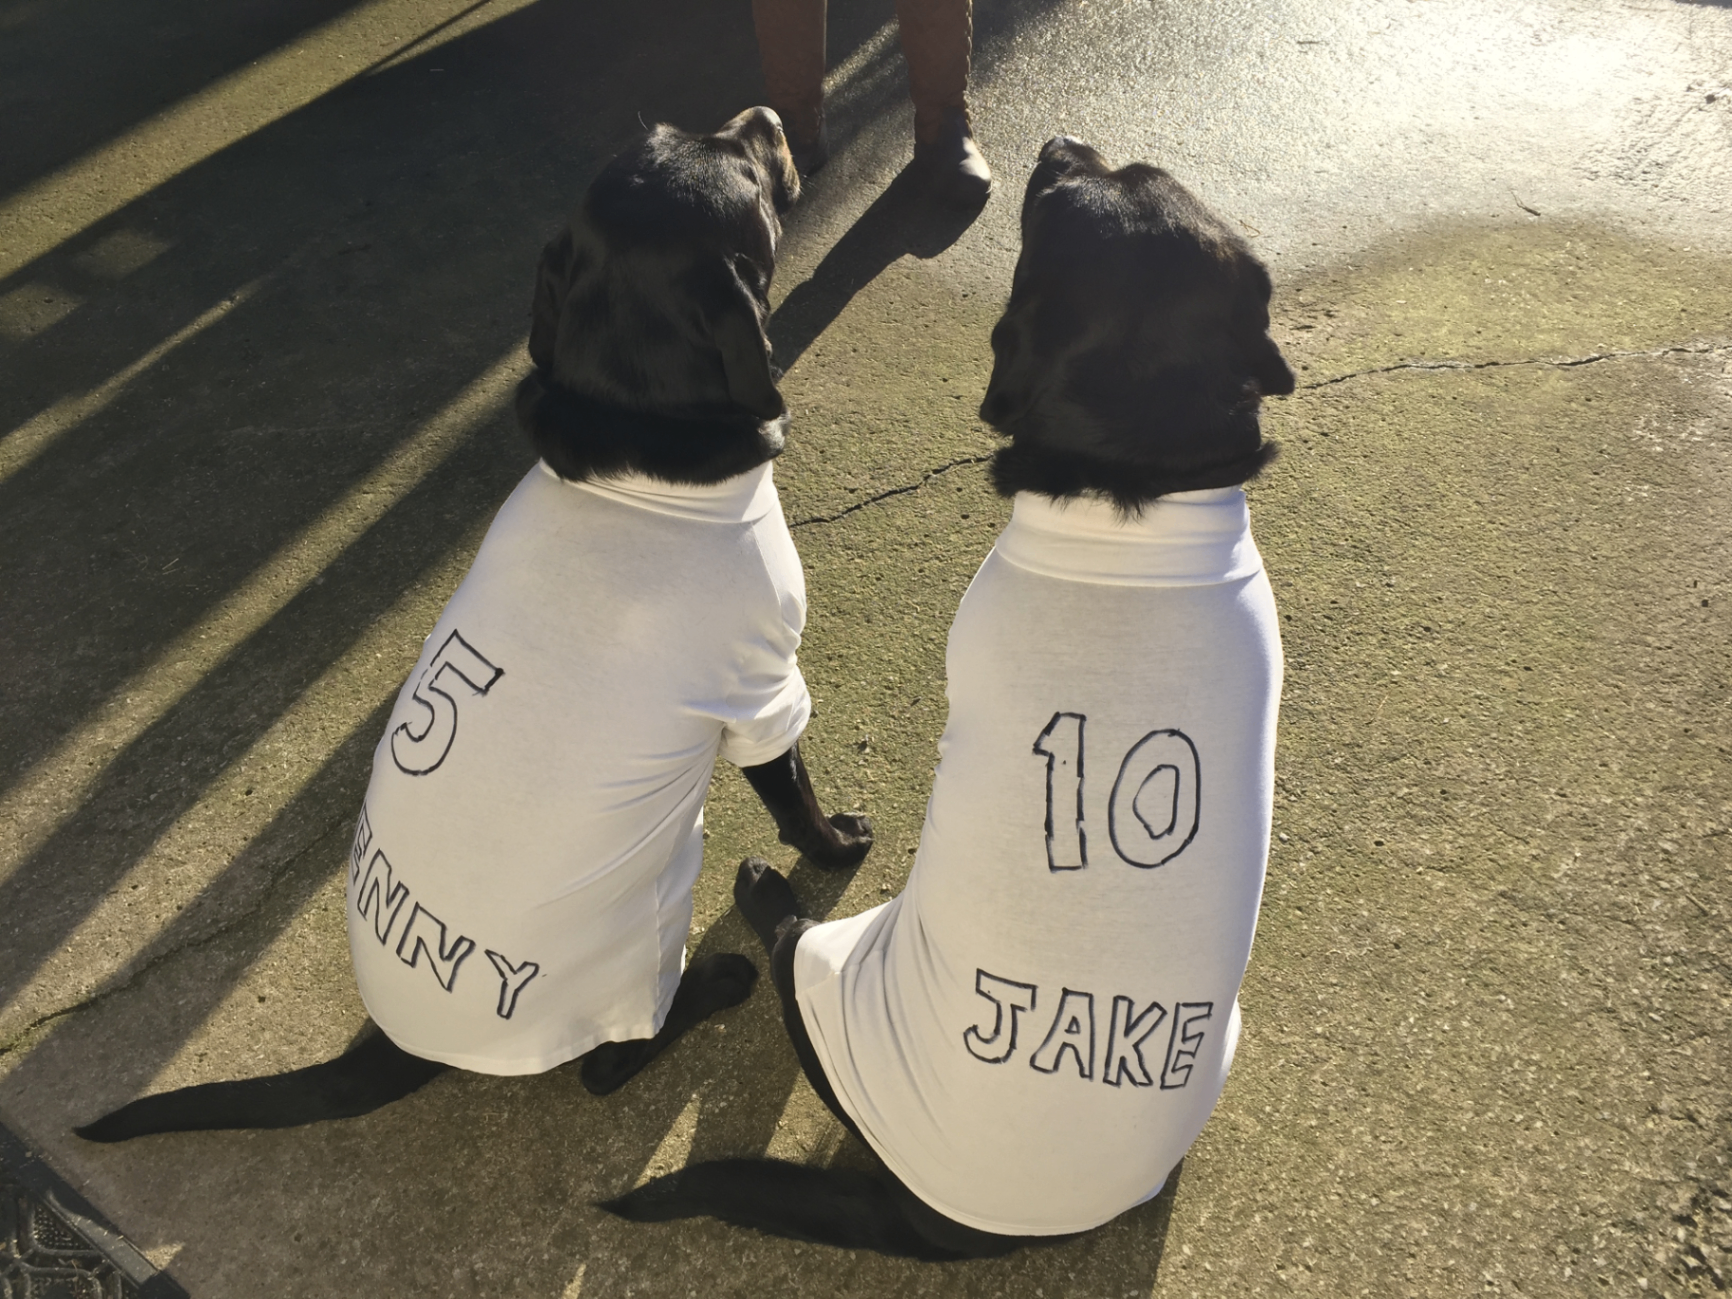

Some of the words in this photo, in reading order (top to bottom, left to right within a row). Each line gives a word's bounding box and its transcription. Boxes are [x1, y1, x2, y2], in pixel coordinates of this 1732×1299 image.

[391, 629, 505, 776] 5
[1032, 711, 1201, 874] 10
[963, 968, 1214, 1090] JAKE
